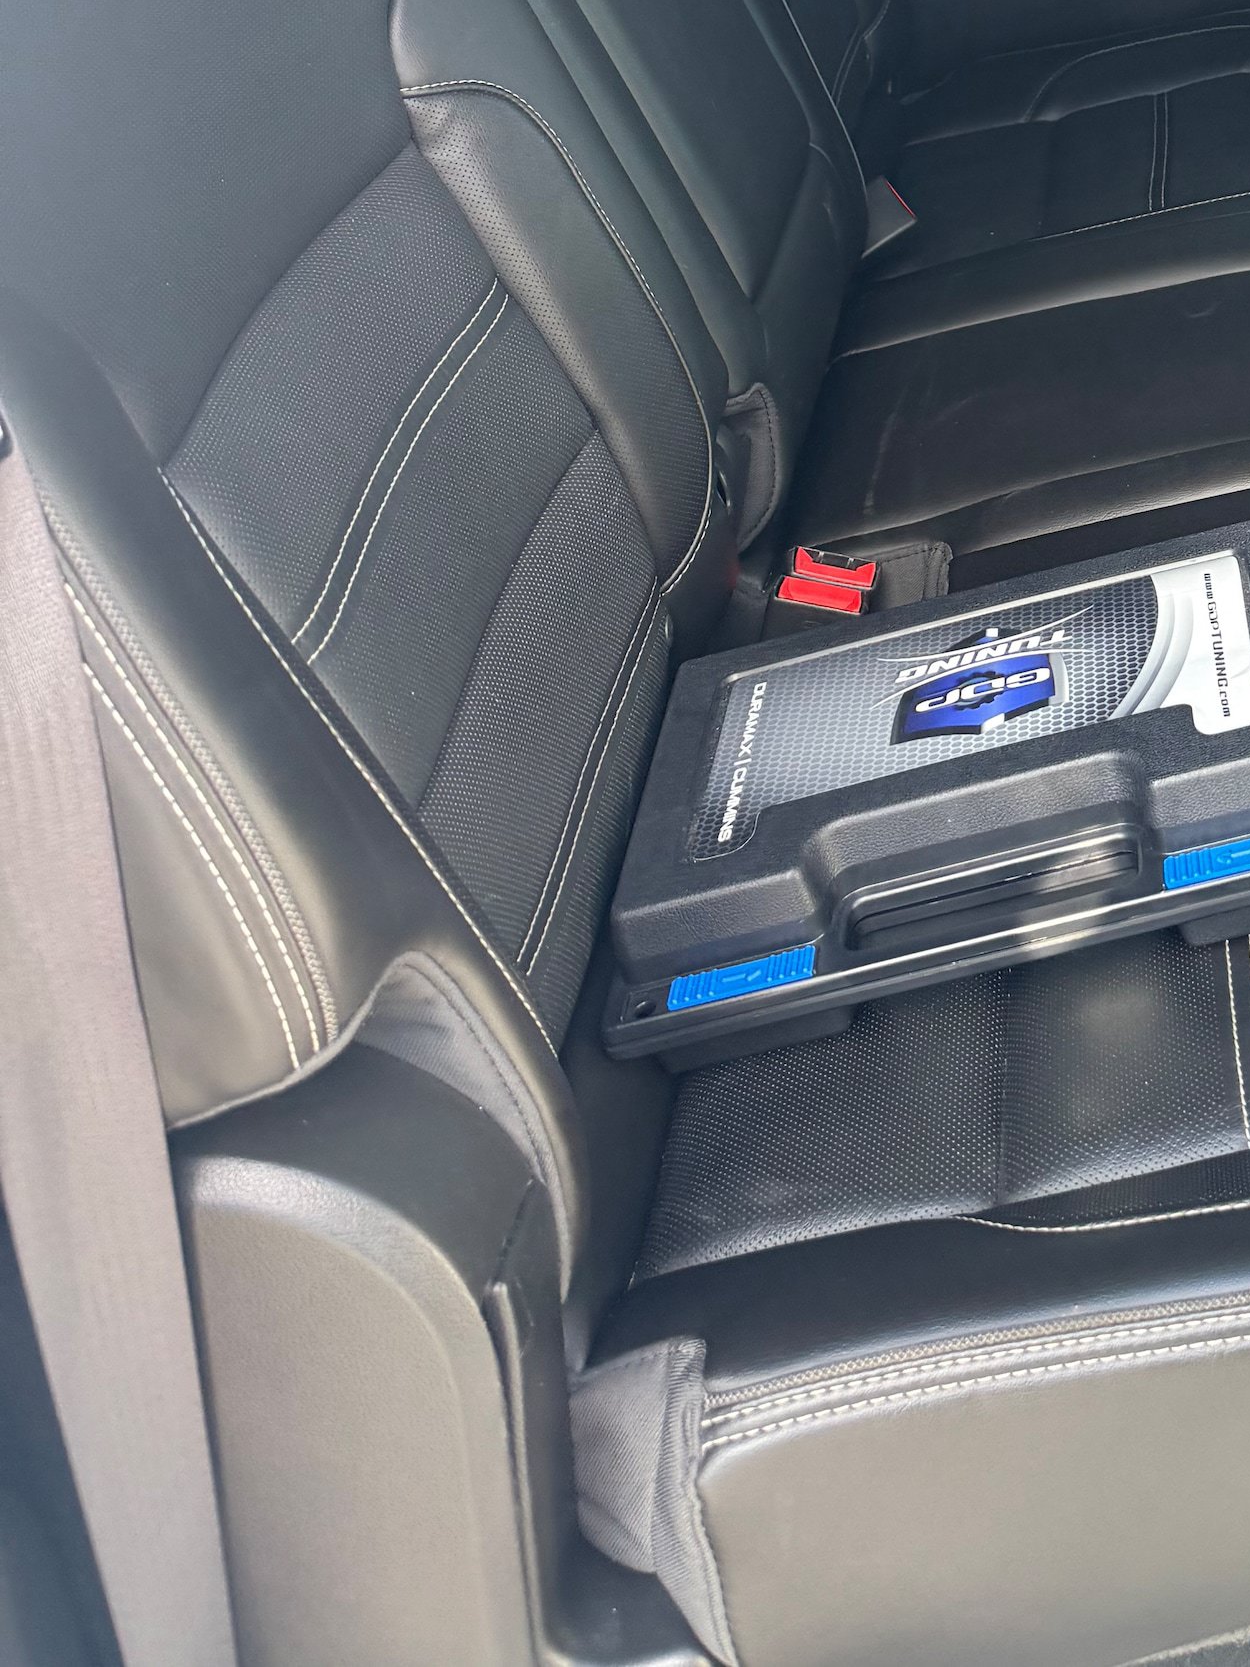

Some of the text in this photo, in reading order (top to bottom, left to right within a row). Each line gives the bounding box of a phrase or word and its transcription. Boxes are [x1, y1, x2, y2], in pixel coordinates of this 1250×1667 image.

[894, 629, 1073, 684] TUNING
[915, 667, 1051, 713] GDP
[717, 682, 767, 843] DURAMAX CUMMINS
